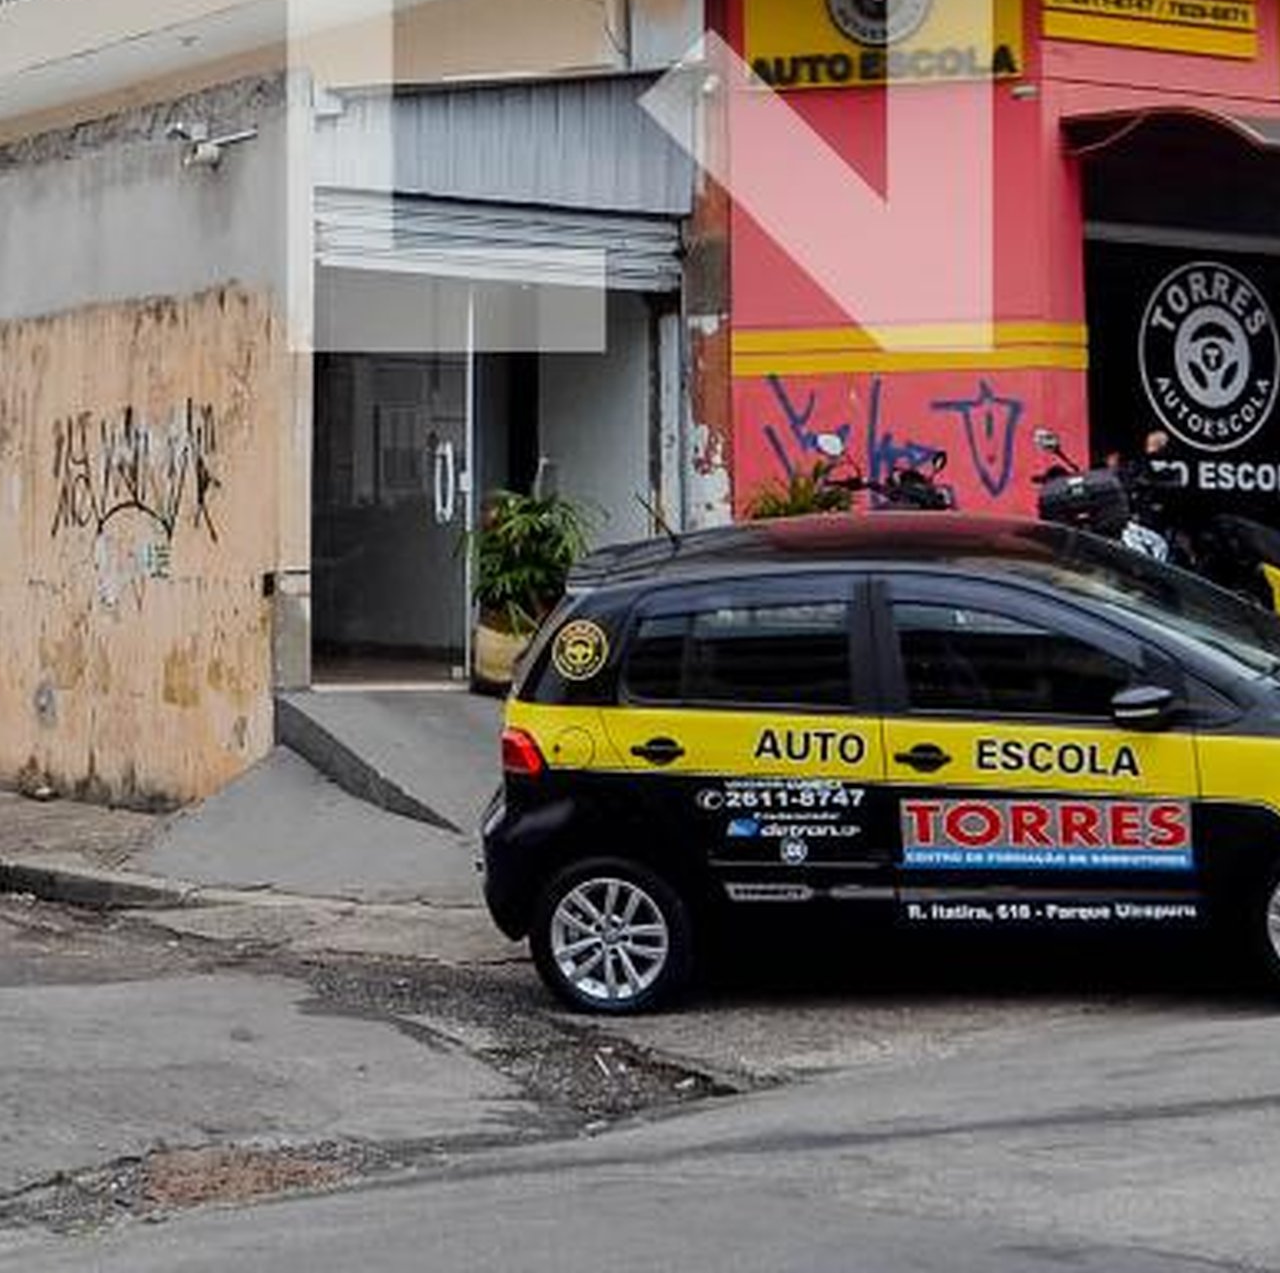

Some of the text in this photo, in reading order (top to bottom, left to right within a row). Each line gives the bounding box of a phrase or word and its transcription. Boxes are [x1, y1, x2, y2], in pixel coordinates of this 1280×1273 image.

[749, 44, 1018, 84] AUTO ESCOLA
[1151, 271, 1267, 335] TORRES
[1156, 377, 1270, 438] AUTOESCOLA
[754, 728, 1140, 777] AUTO ESCOLA
[726, 789, 865, 808] 2611-8747
[904, 800, 1190, 848] TORRES
[1045, 903, 1111, 922] Parque
